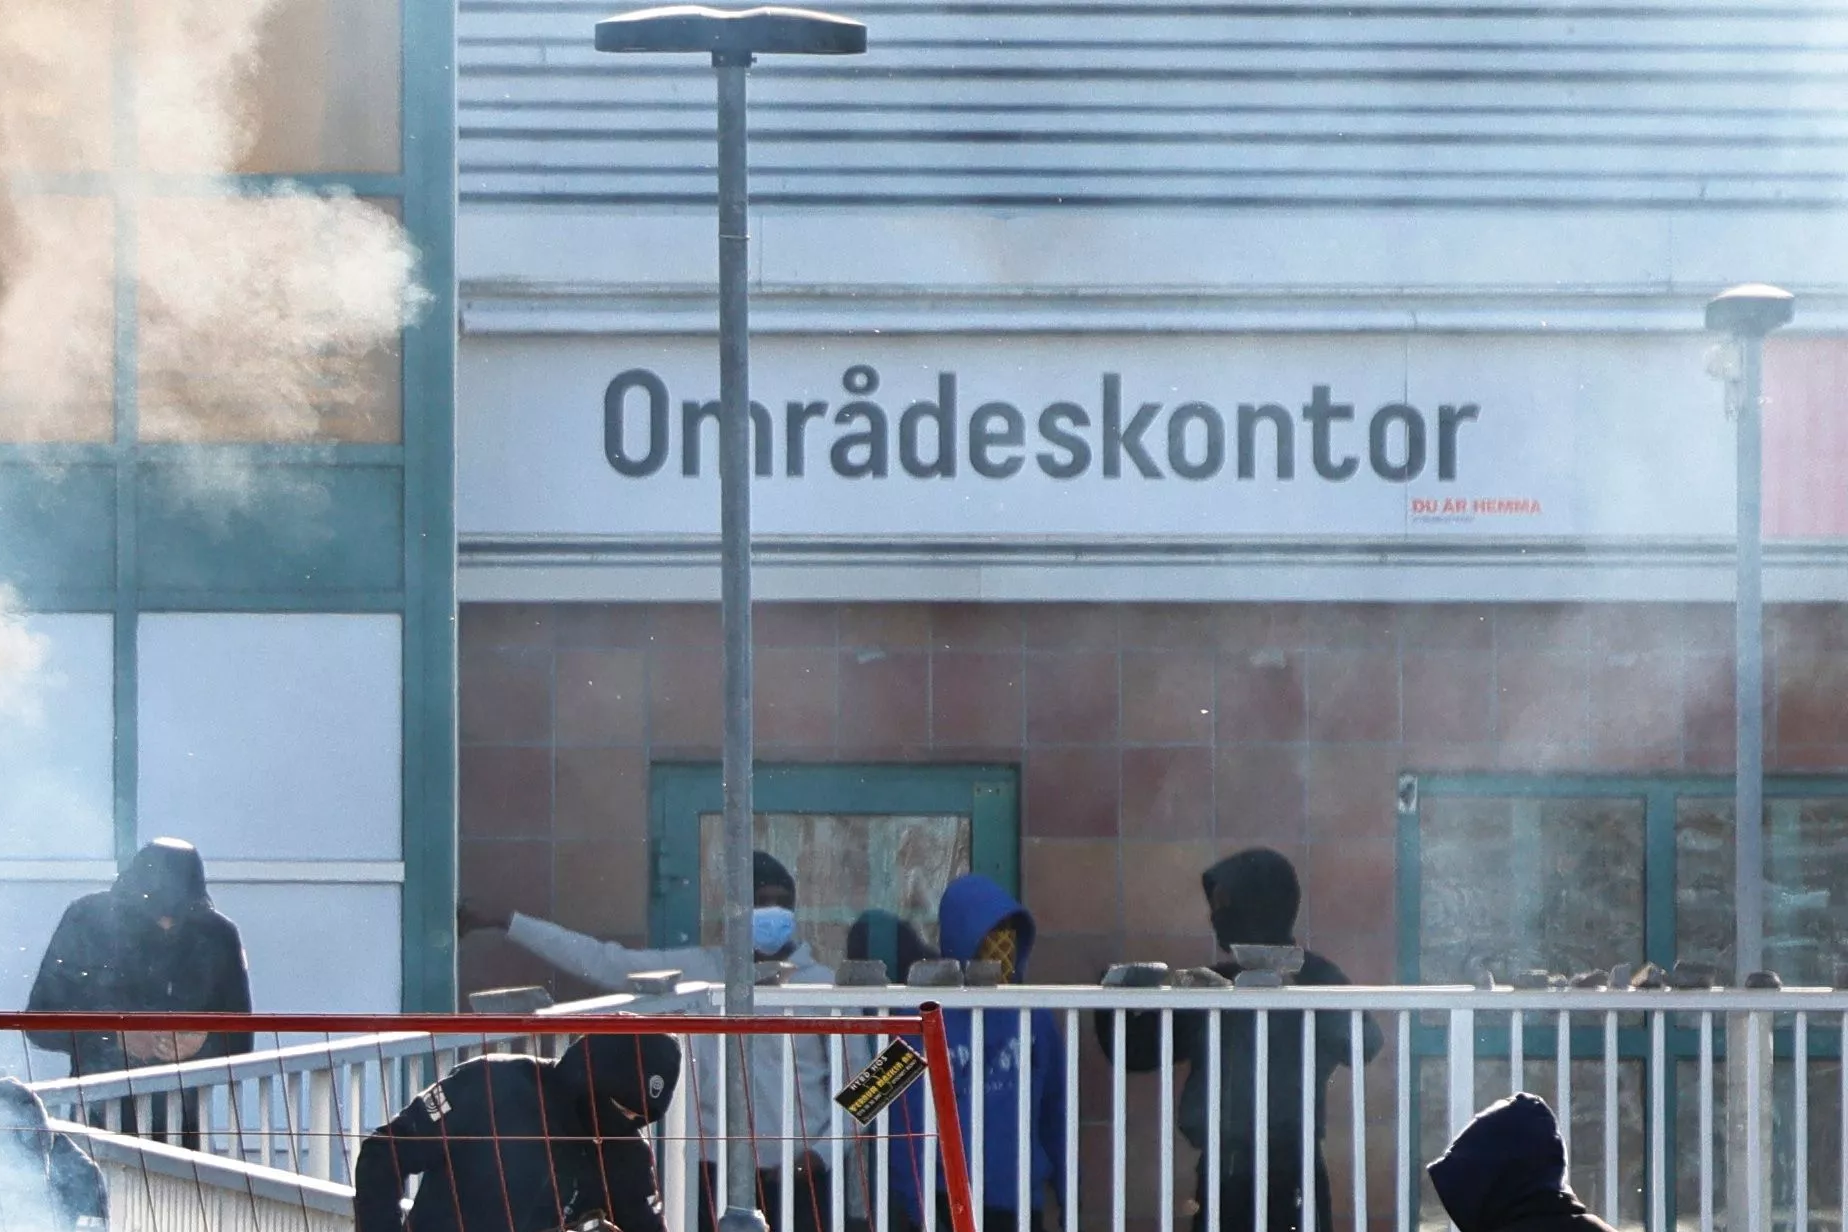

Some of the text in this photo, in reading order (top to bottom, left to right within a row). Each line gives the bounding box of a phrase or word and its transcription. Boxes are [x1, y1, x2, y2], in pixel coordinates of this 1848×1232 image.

[604, 364, 1480, 482] Områdeskontor
[1411, 498, 1438, 514] DU
[1473, 498, 1542, 515] HEMMA
[871, 1055, 888, 1071] HOS
